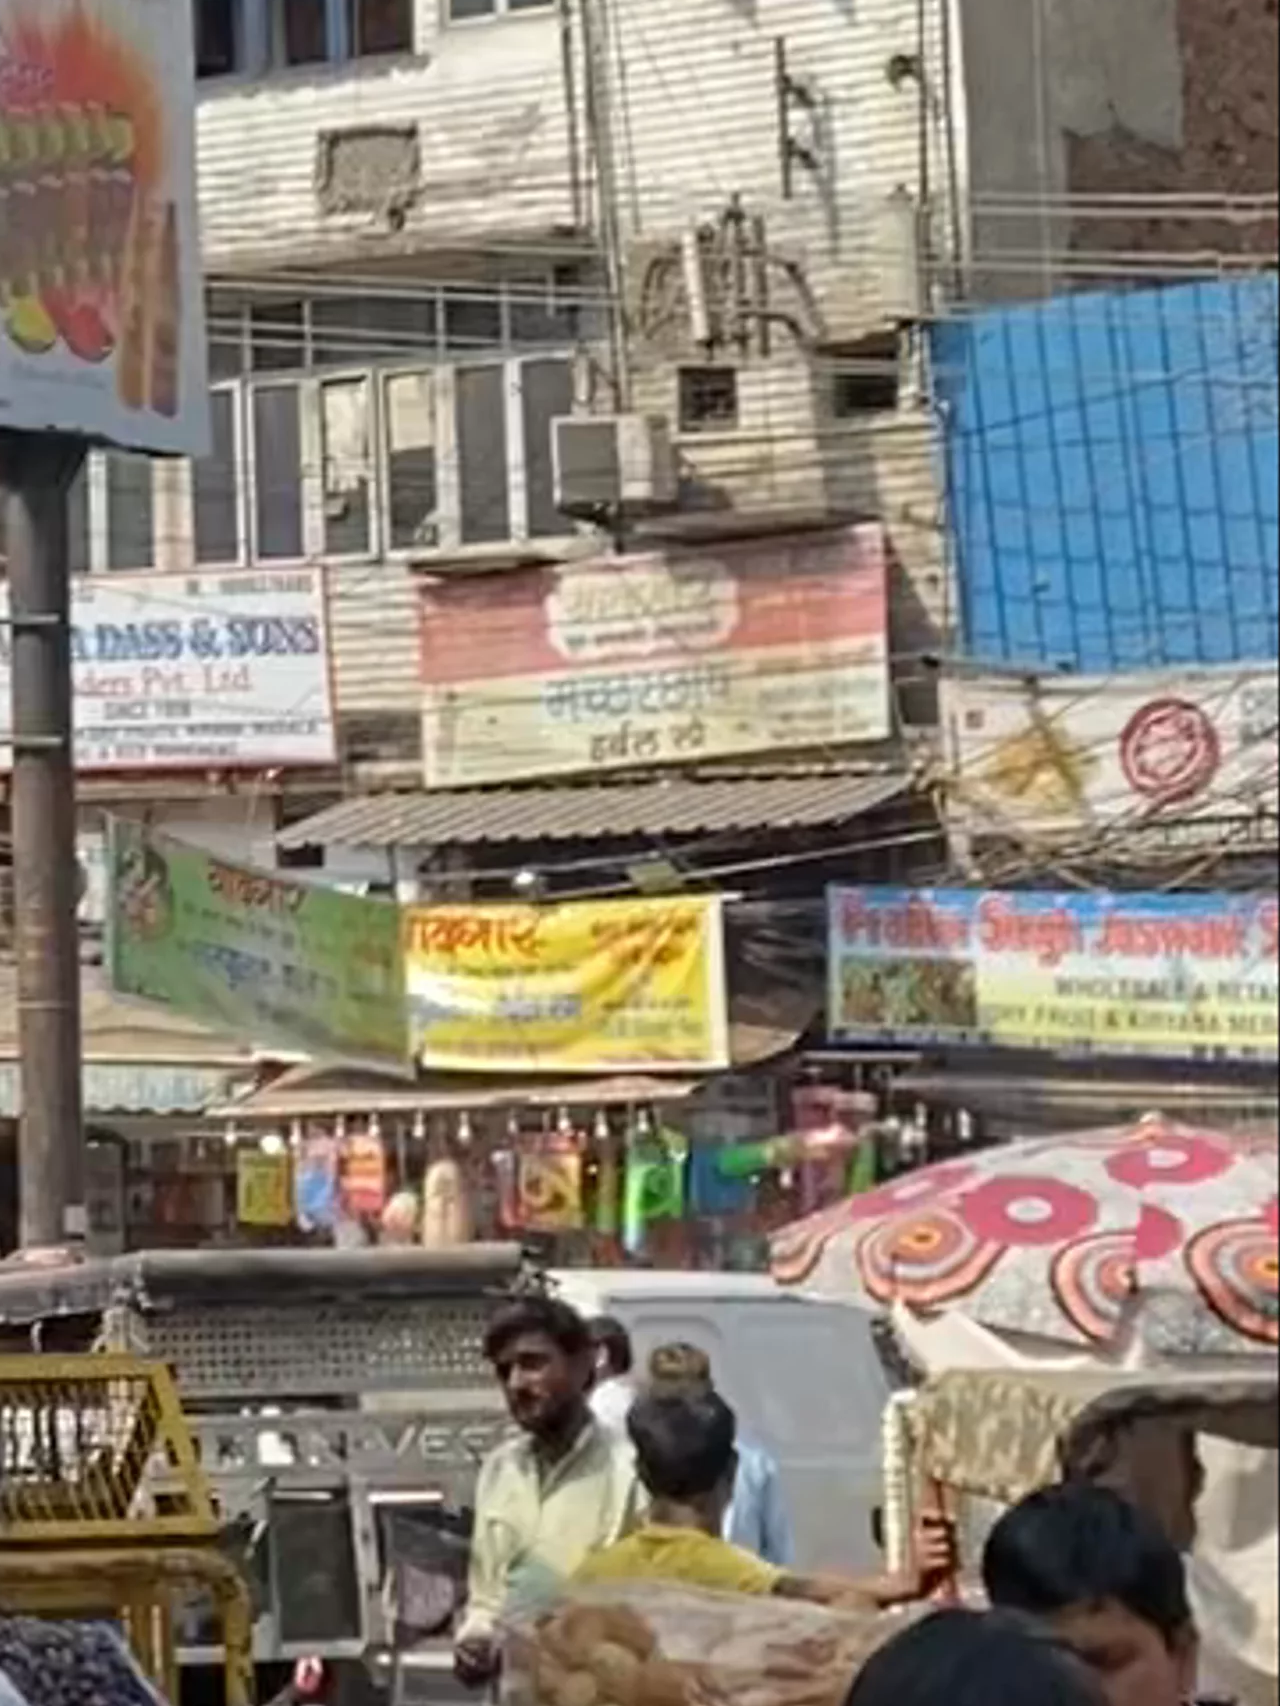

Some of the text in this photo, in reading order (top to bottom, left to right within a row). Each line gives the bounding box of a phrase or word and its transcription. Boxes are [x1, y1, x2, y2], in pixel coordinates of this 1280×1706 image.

[96, 619, 184, 661] DASS
[190, 617, 223, 657] &
[227, 614, 320, 655] SONS
